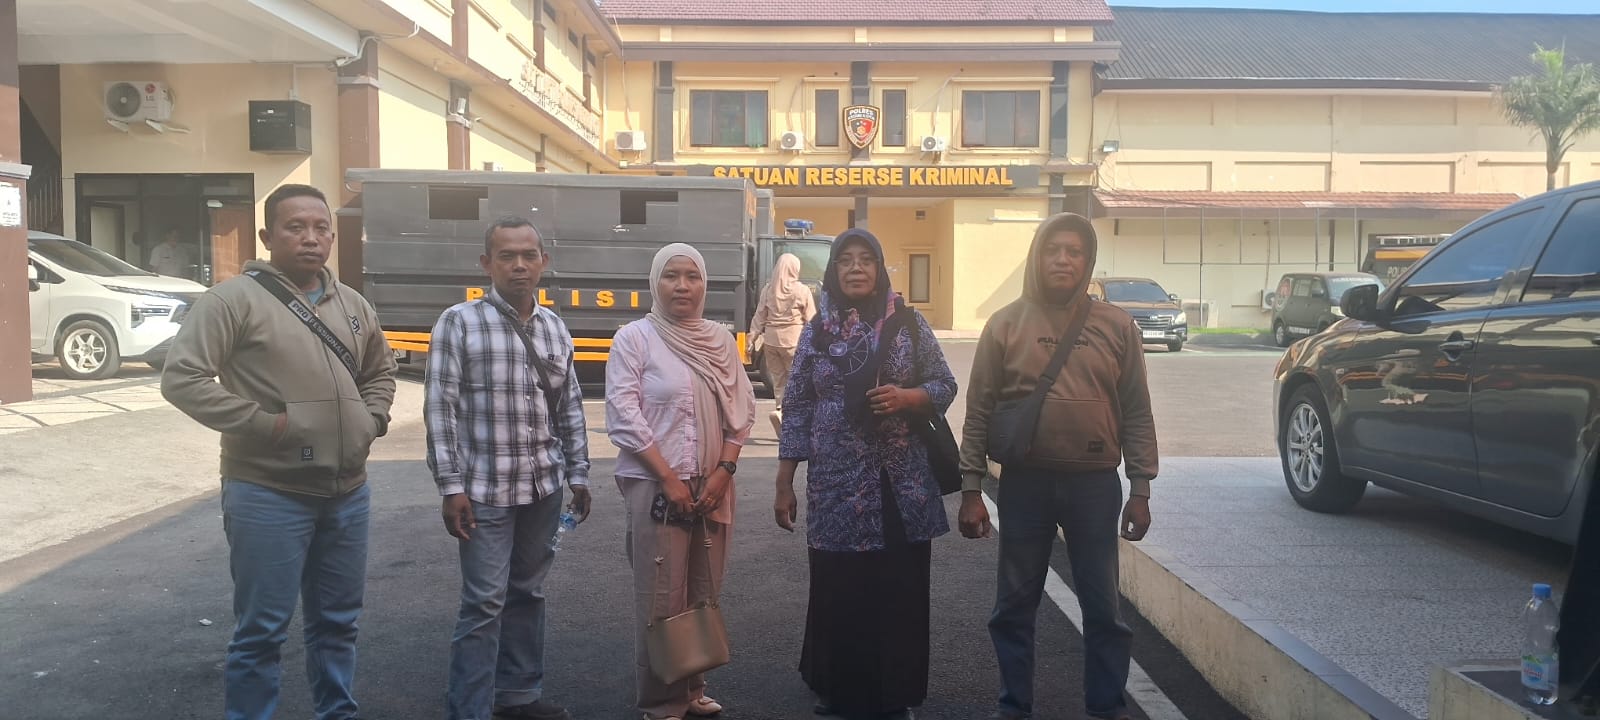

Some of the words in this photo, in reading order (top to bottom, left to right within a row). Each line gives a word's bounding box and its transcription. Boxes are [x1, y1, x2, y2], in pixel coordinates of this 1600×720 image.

[713, 167, 799, 186] SATUAN
[805, 167, 903, 186] RESERSE
[909, 167, 1013, 186] KRIMINAL
[466, 287, 639, 308] PLISI
